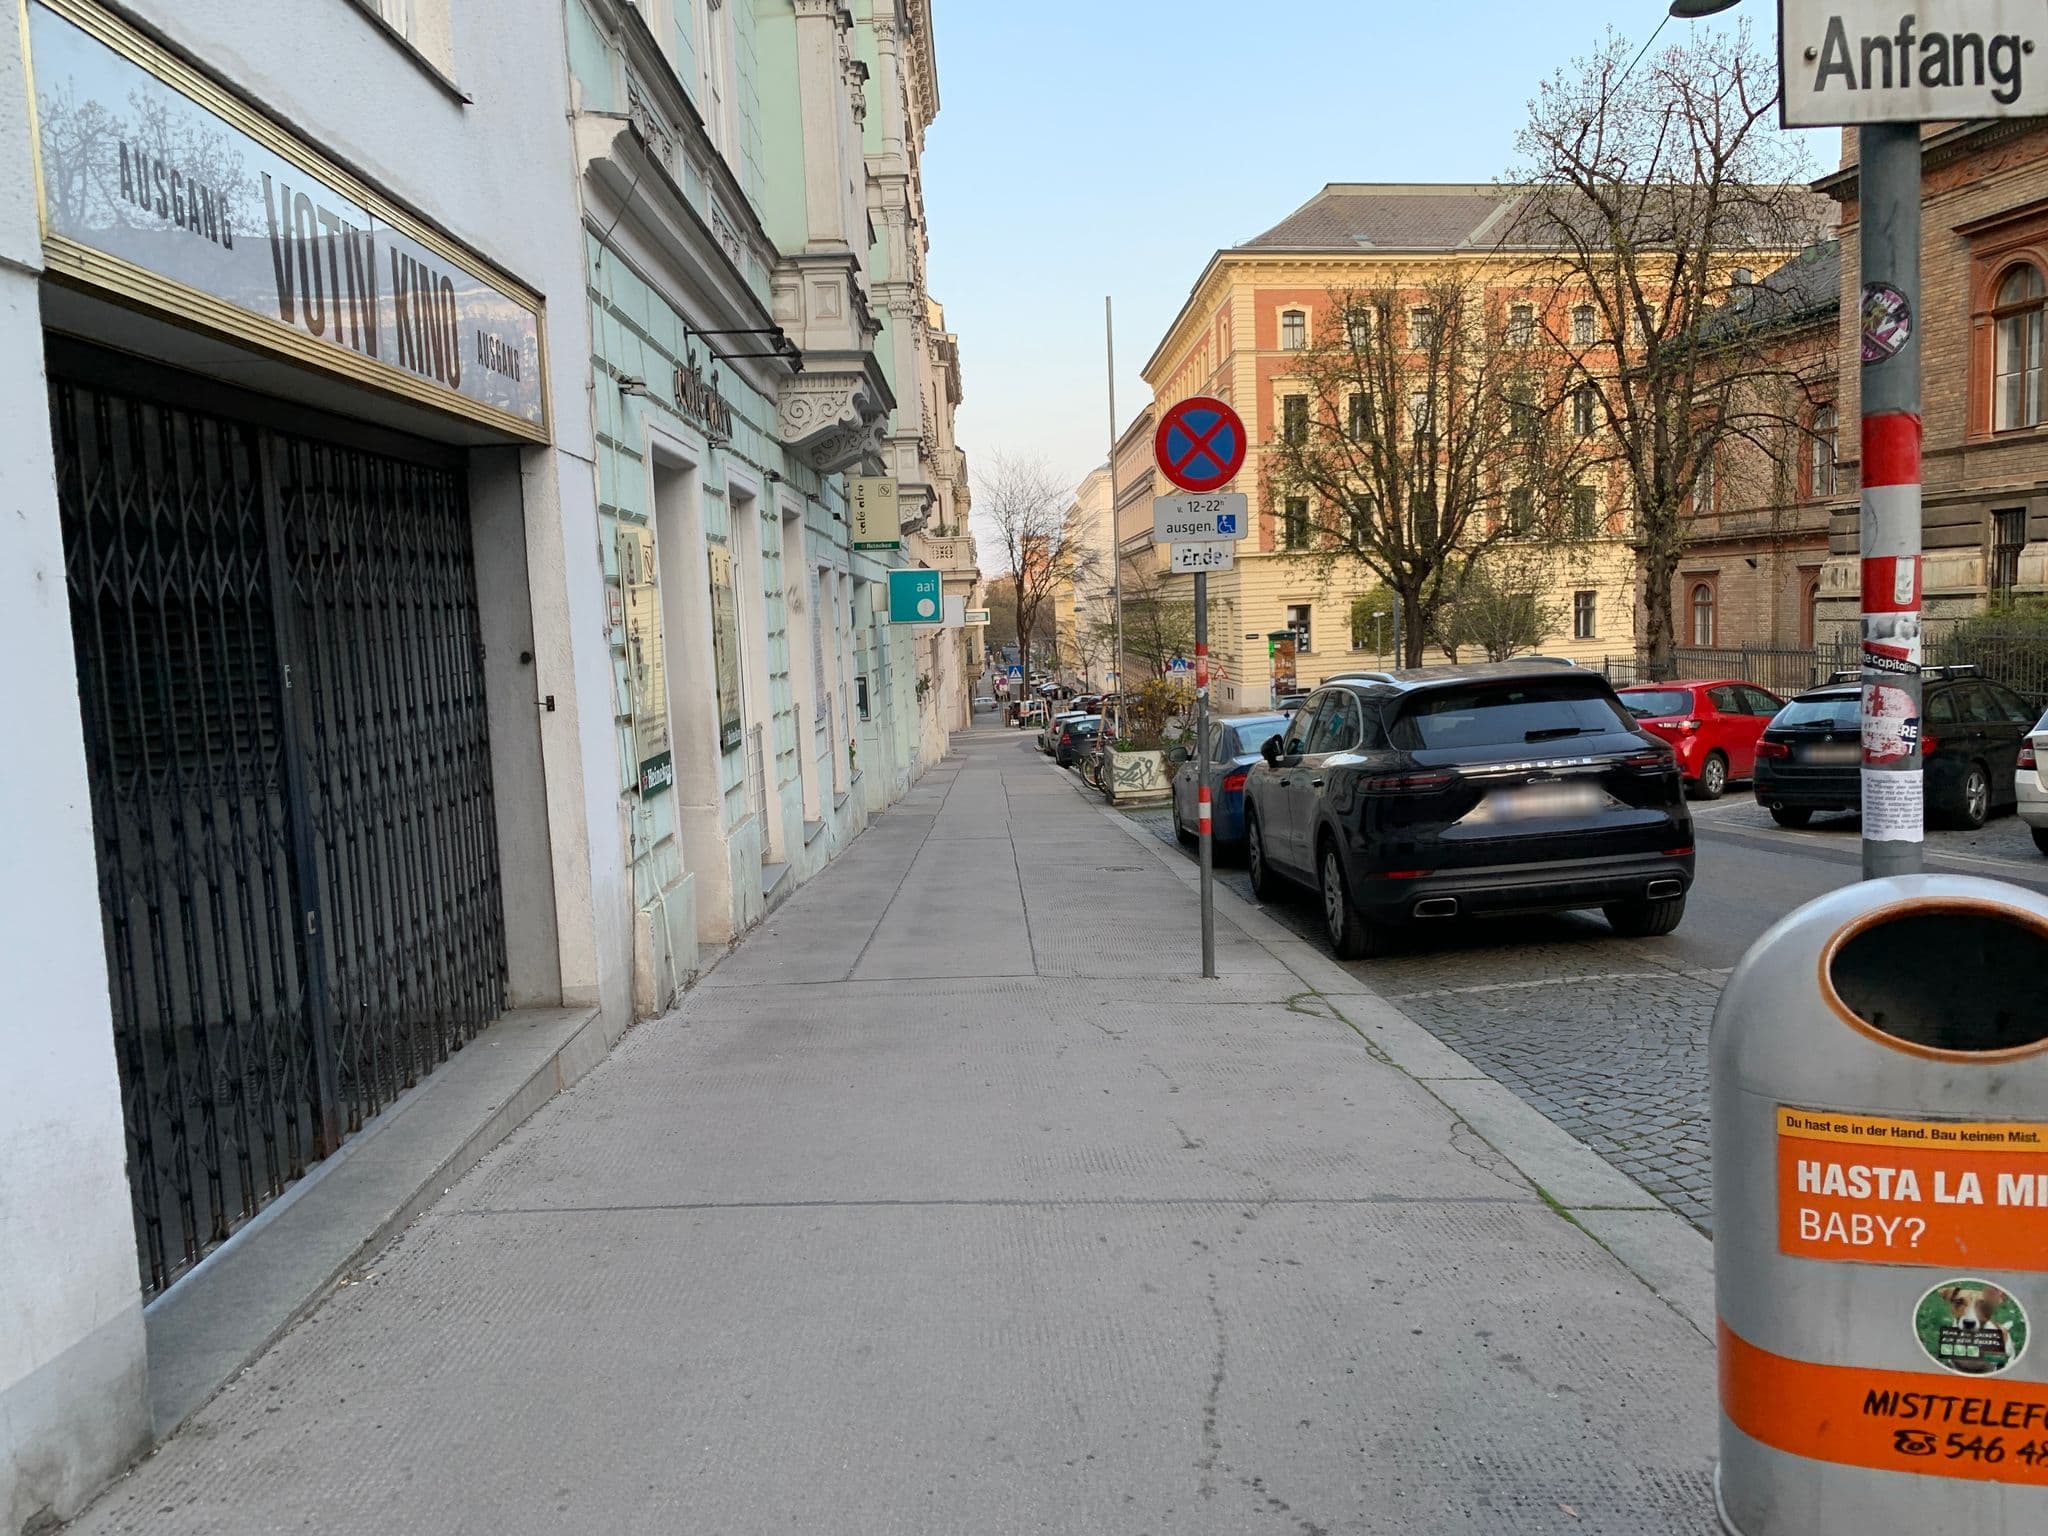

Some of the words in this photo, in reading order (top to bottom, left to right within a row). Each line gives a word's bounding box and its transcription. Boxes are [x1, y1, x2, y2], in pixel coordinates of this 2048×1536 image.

[1813, 14, 2022, 105] Anfang
[119, 140, 233, 250] AUSGANG
[260, 171, 378, 358] VOTIV
[390, 246, 461, 390] KINO
[477, 329, 520, 382] AUSGANG
[854, 484, 866, 508] afro
[855, 511, 866, 534] café
[1166, 522, 1215, 535] ausgen.
[1182, 547, 1222, 566] Ende
[916, 580, 935, 592] aai
[1490, 758, 1592, 772] PORSCHE
[1786, 1116, 1801, 1128] Du
[1805, 1119, 1831, 1132] hast
[1834, 1123, 1848, 1134] es
[1852, 1123, 1863, 1135] in
[1867, 1125, 1888, 1136] der
[1891, 1127, 1928, 1139] Hand.
[1931, 1129, 1957, 1141] Bau
[1960, 1131, 2004, 1142] keinen
[2008, 1132, 2041, 1143] Mist.
[1798, 1160, 1922, 1202] HASTA
[1934, 1171, 1984, 1205] LA
[1997, 1173, 2048, 1207] MI
[1800, 1208, 1926, 1248] BABY?
[1863, 1389, 2048, 1431] MISTTELEF
[1944, 1432, 2006, 1464] 546
